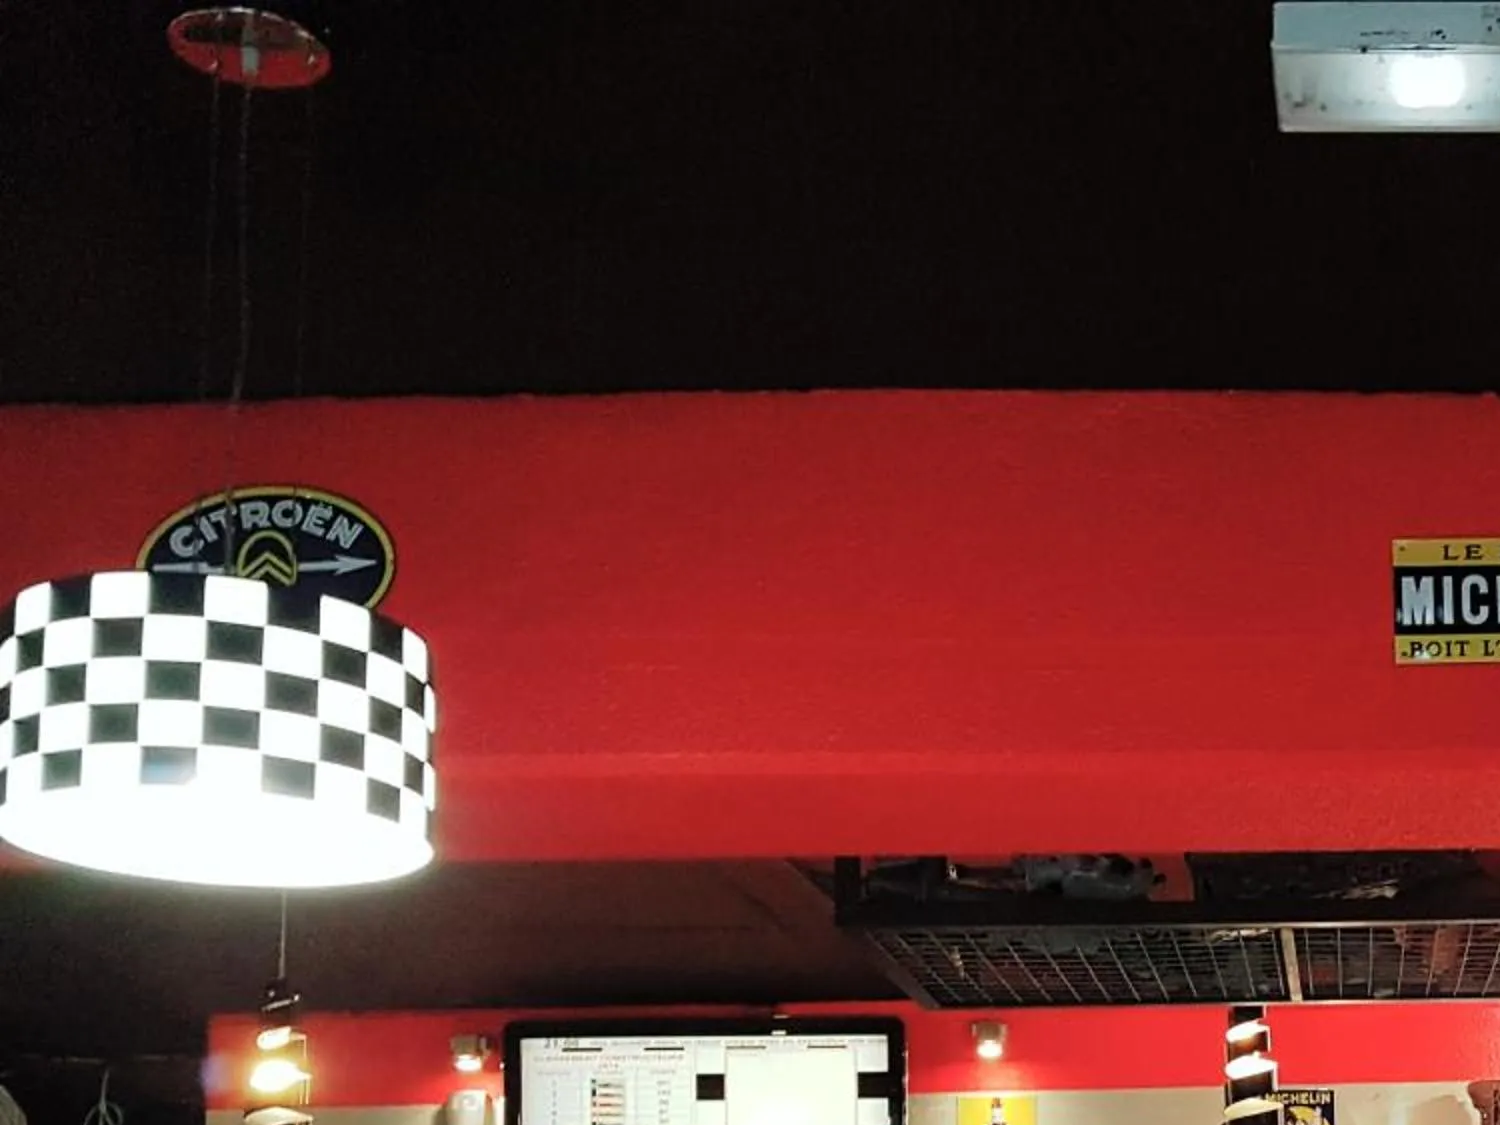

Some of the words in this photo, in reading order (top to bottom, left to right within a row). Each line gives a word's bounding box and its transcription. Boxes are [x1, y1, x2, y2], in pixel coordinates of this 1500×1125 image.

[169, 499, 364, 557] CITROËN
[1442, 544, 1484, 560] LE
[1265, 1092, 1331, 1105] MICHELIN
